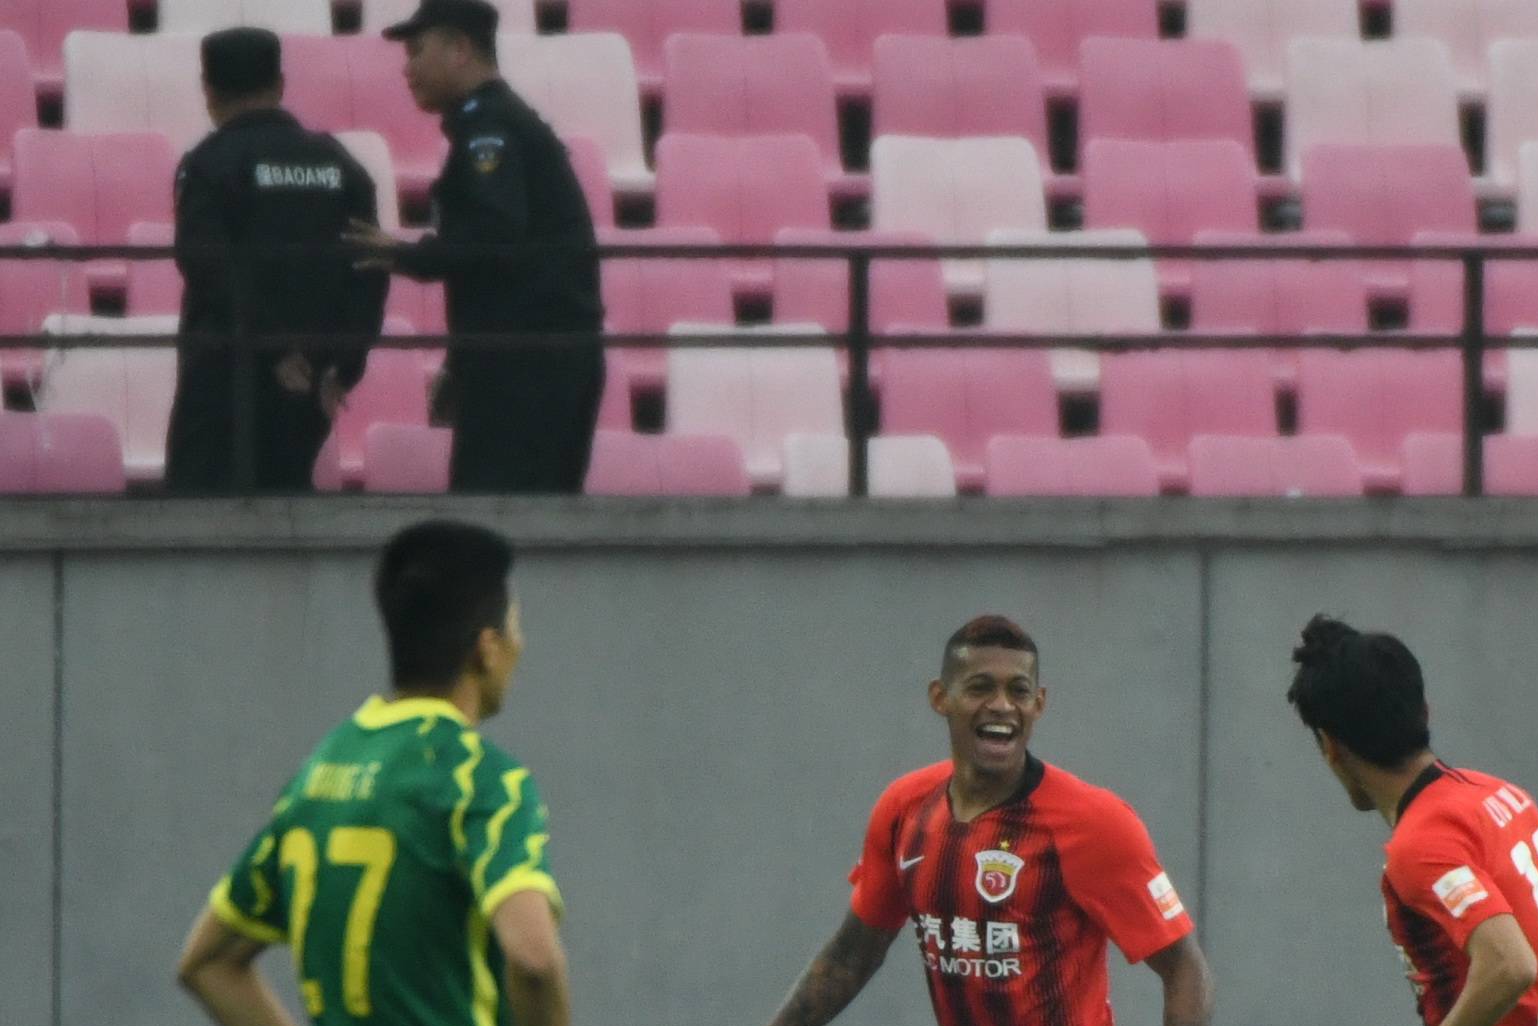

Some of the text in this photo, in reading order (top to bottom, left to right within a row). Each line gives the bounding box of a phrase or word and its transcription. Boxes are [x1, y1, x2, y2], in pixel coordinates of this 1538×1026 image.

[915, 913, 1020, 954] 汽集团
[940, 956, 1021, 977] MOTOR
